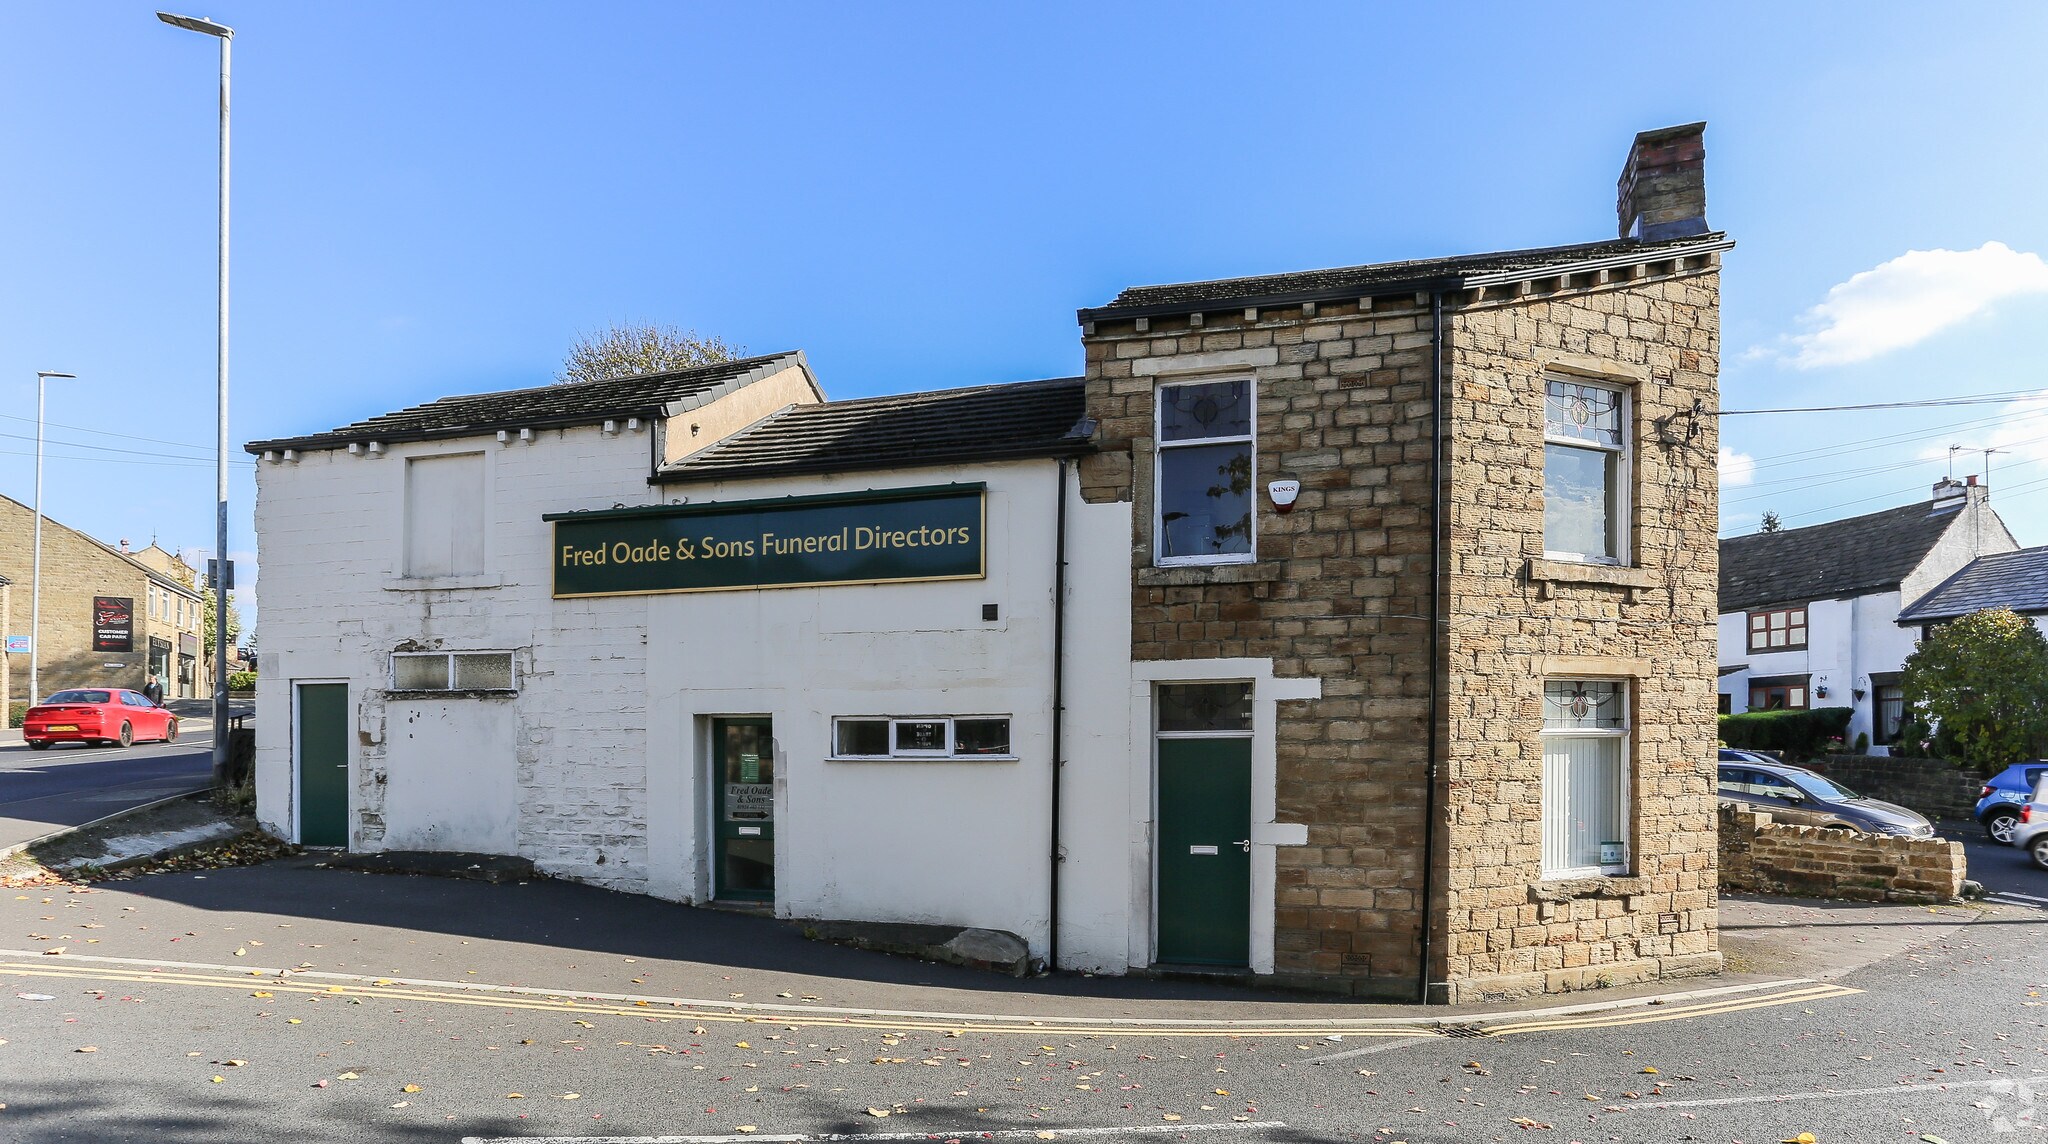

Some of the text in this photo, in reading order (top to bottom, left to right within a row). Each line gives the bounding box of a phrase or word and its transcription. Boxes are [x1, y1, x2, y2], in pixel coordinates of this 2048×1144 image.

[562, 526, 970, 567] Fred Oade & Sons Funeral Directors
[730, 786, 772, 794] Fred Oade
[736, 795, 766, 803] & Sons
